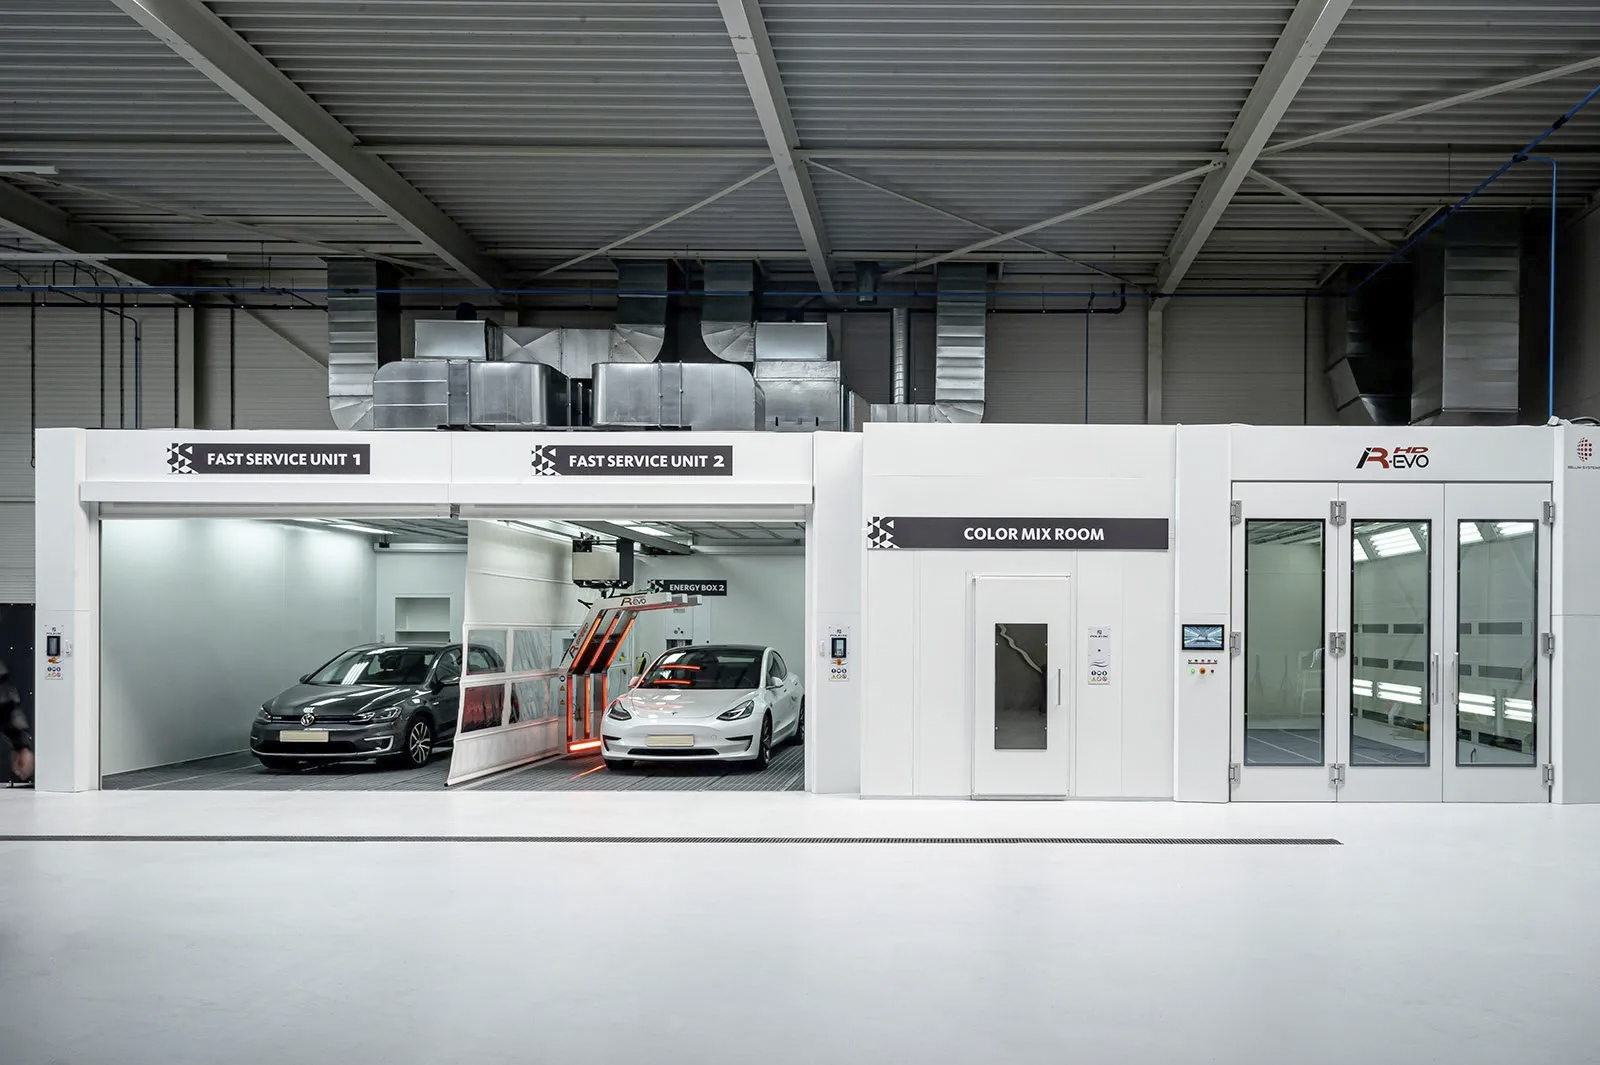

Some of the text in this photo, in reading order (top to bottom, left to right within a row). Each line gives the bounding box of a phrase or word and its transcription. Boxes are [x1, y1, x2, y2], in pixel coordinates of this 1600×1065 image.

[1393, 446, 1429, 454] HD
[207, 453, 361, 466] FAST SERVICE UNIT 1
[569, 455, 725, 468] FAST SERVICE UNIT 2
[963, 527, 1105, 541] COLOR MIX ROOM
[669, 584, 701, 592] ENERGY
[718, 584, 725, 592] 2
